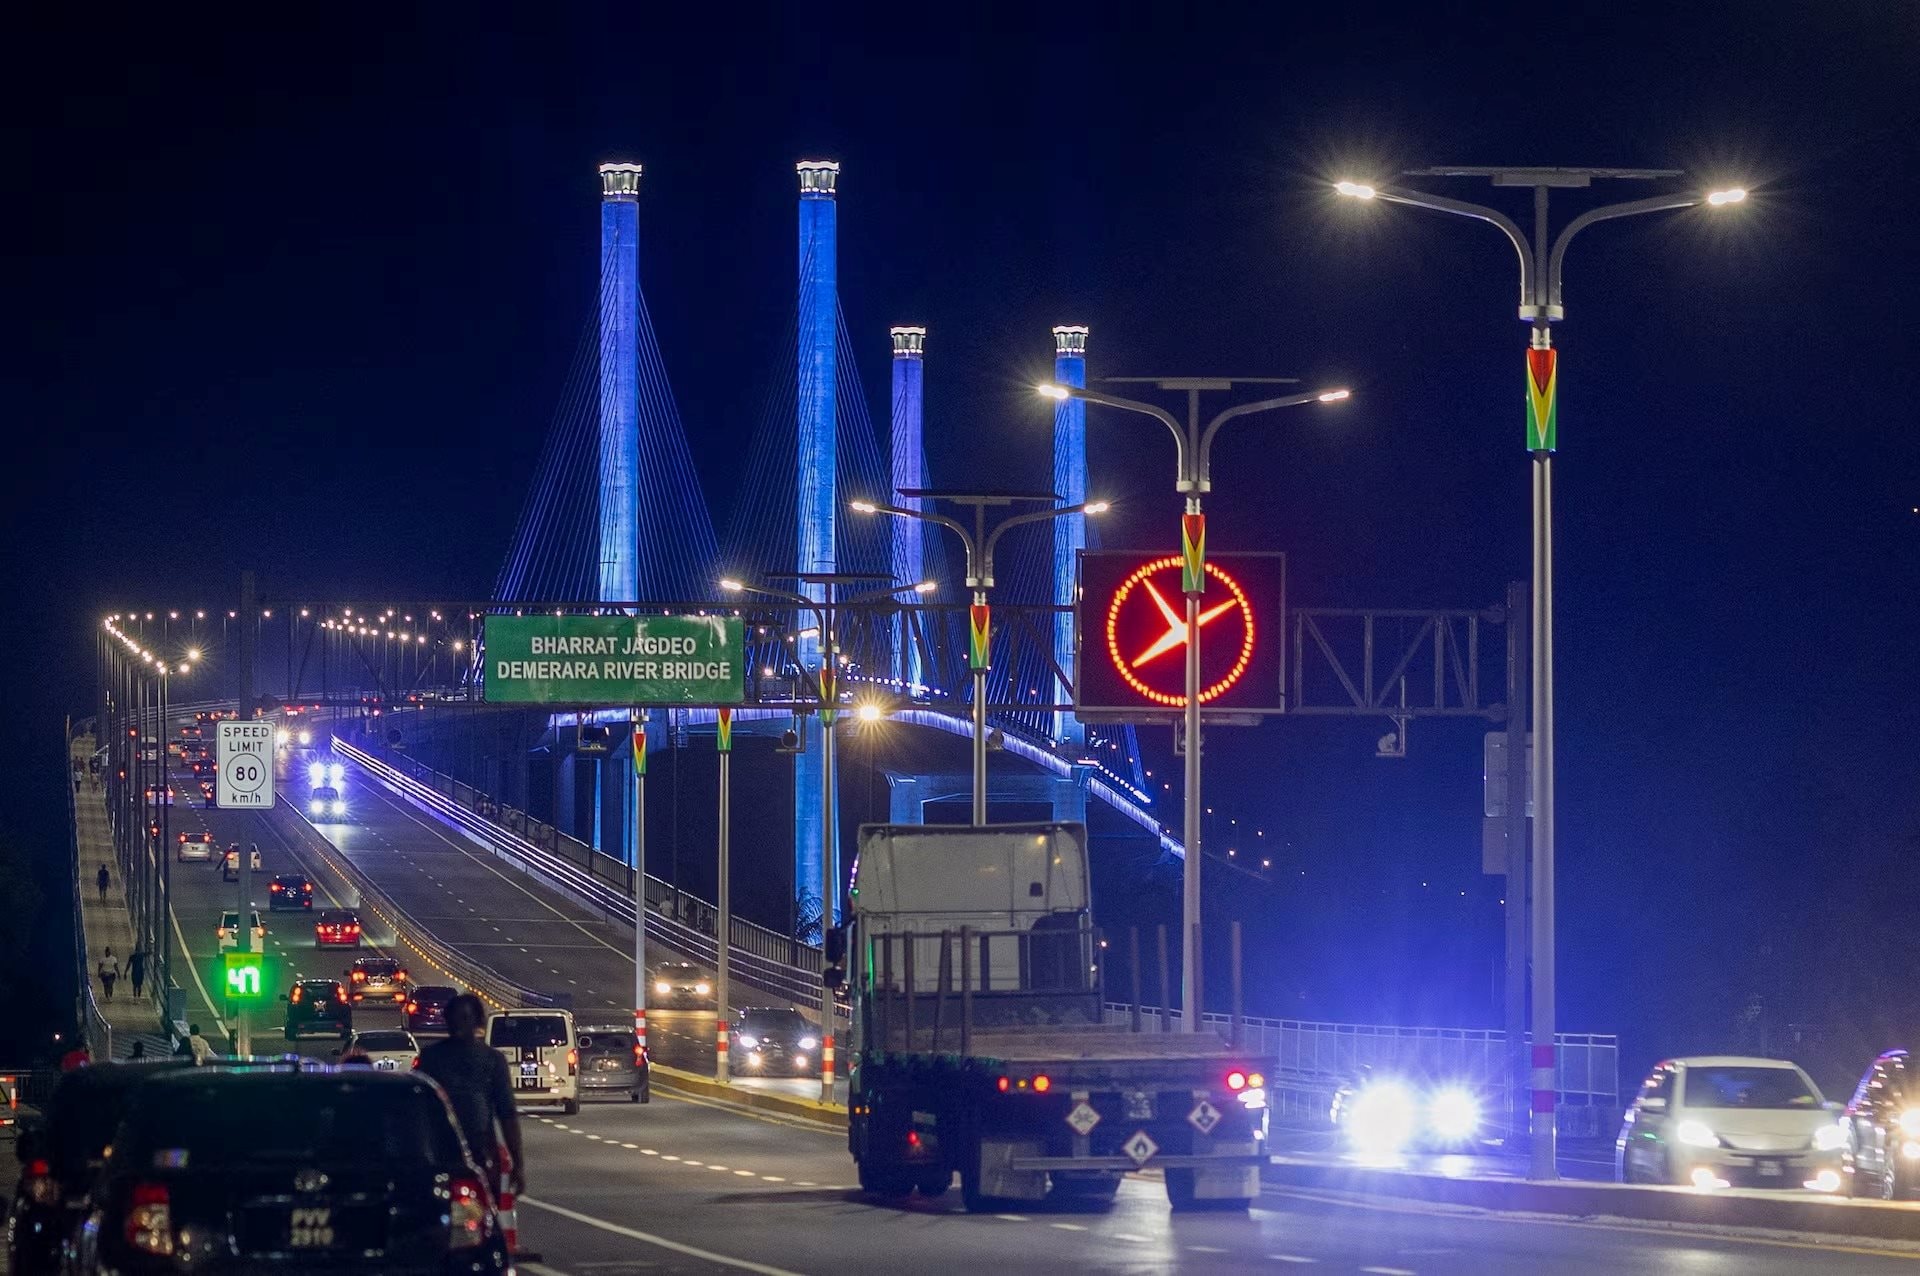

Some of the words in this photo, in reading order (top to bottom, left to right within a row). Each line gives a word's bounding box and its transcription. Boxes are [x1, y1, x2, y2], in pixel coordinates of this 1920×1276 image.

[532, 636, 618, 655] BHARRAT
[622, 636, 696, 655] JAGDEO
[497, 661, 599, 680] DEMERARA
[604, 661, 658, 680] RIVER
[662, 661, 731, 680] BRIDGE
[223, 727, 269, 737] SPEED
[229, 742, 263, 752] LIMIT
[236, 766, 257, 781] 80
[232, 793, 261, 803] km/h
